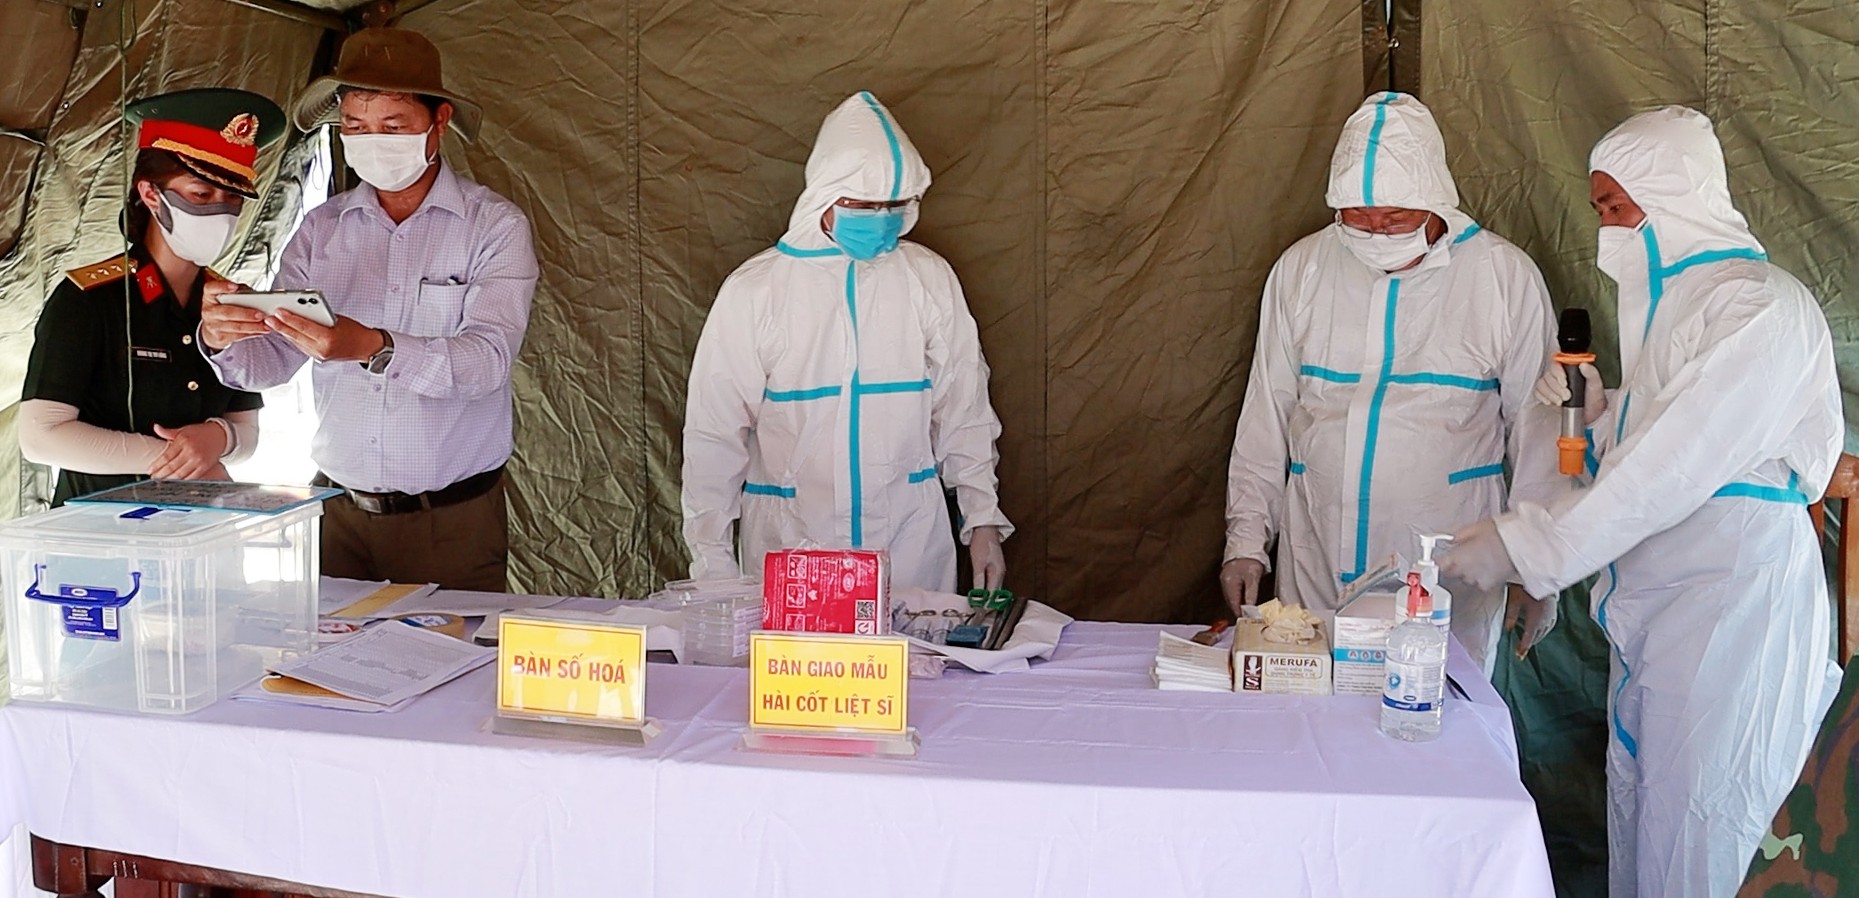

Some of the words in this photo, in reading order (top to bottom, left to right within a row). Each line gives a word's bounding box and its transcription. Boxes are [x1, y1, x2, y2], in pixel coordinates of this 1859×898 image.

[557, 653, 583, 680] SỐ
[589, 659, 626, 684] HOÁ
[768, 655, 801, 676] BÀN
[807, 660, 845, 678] GIAO
[851, 655, 888, 680] MẪU
[1269, 657, 1318, 668] MERUFA
[763, 690, 790, 711] HÀI
[796, 690, 828, 713] CỐT
[834, 694, 871, 718] LIỆT
[877, 695, 894, 716] SĨ
